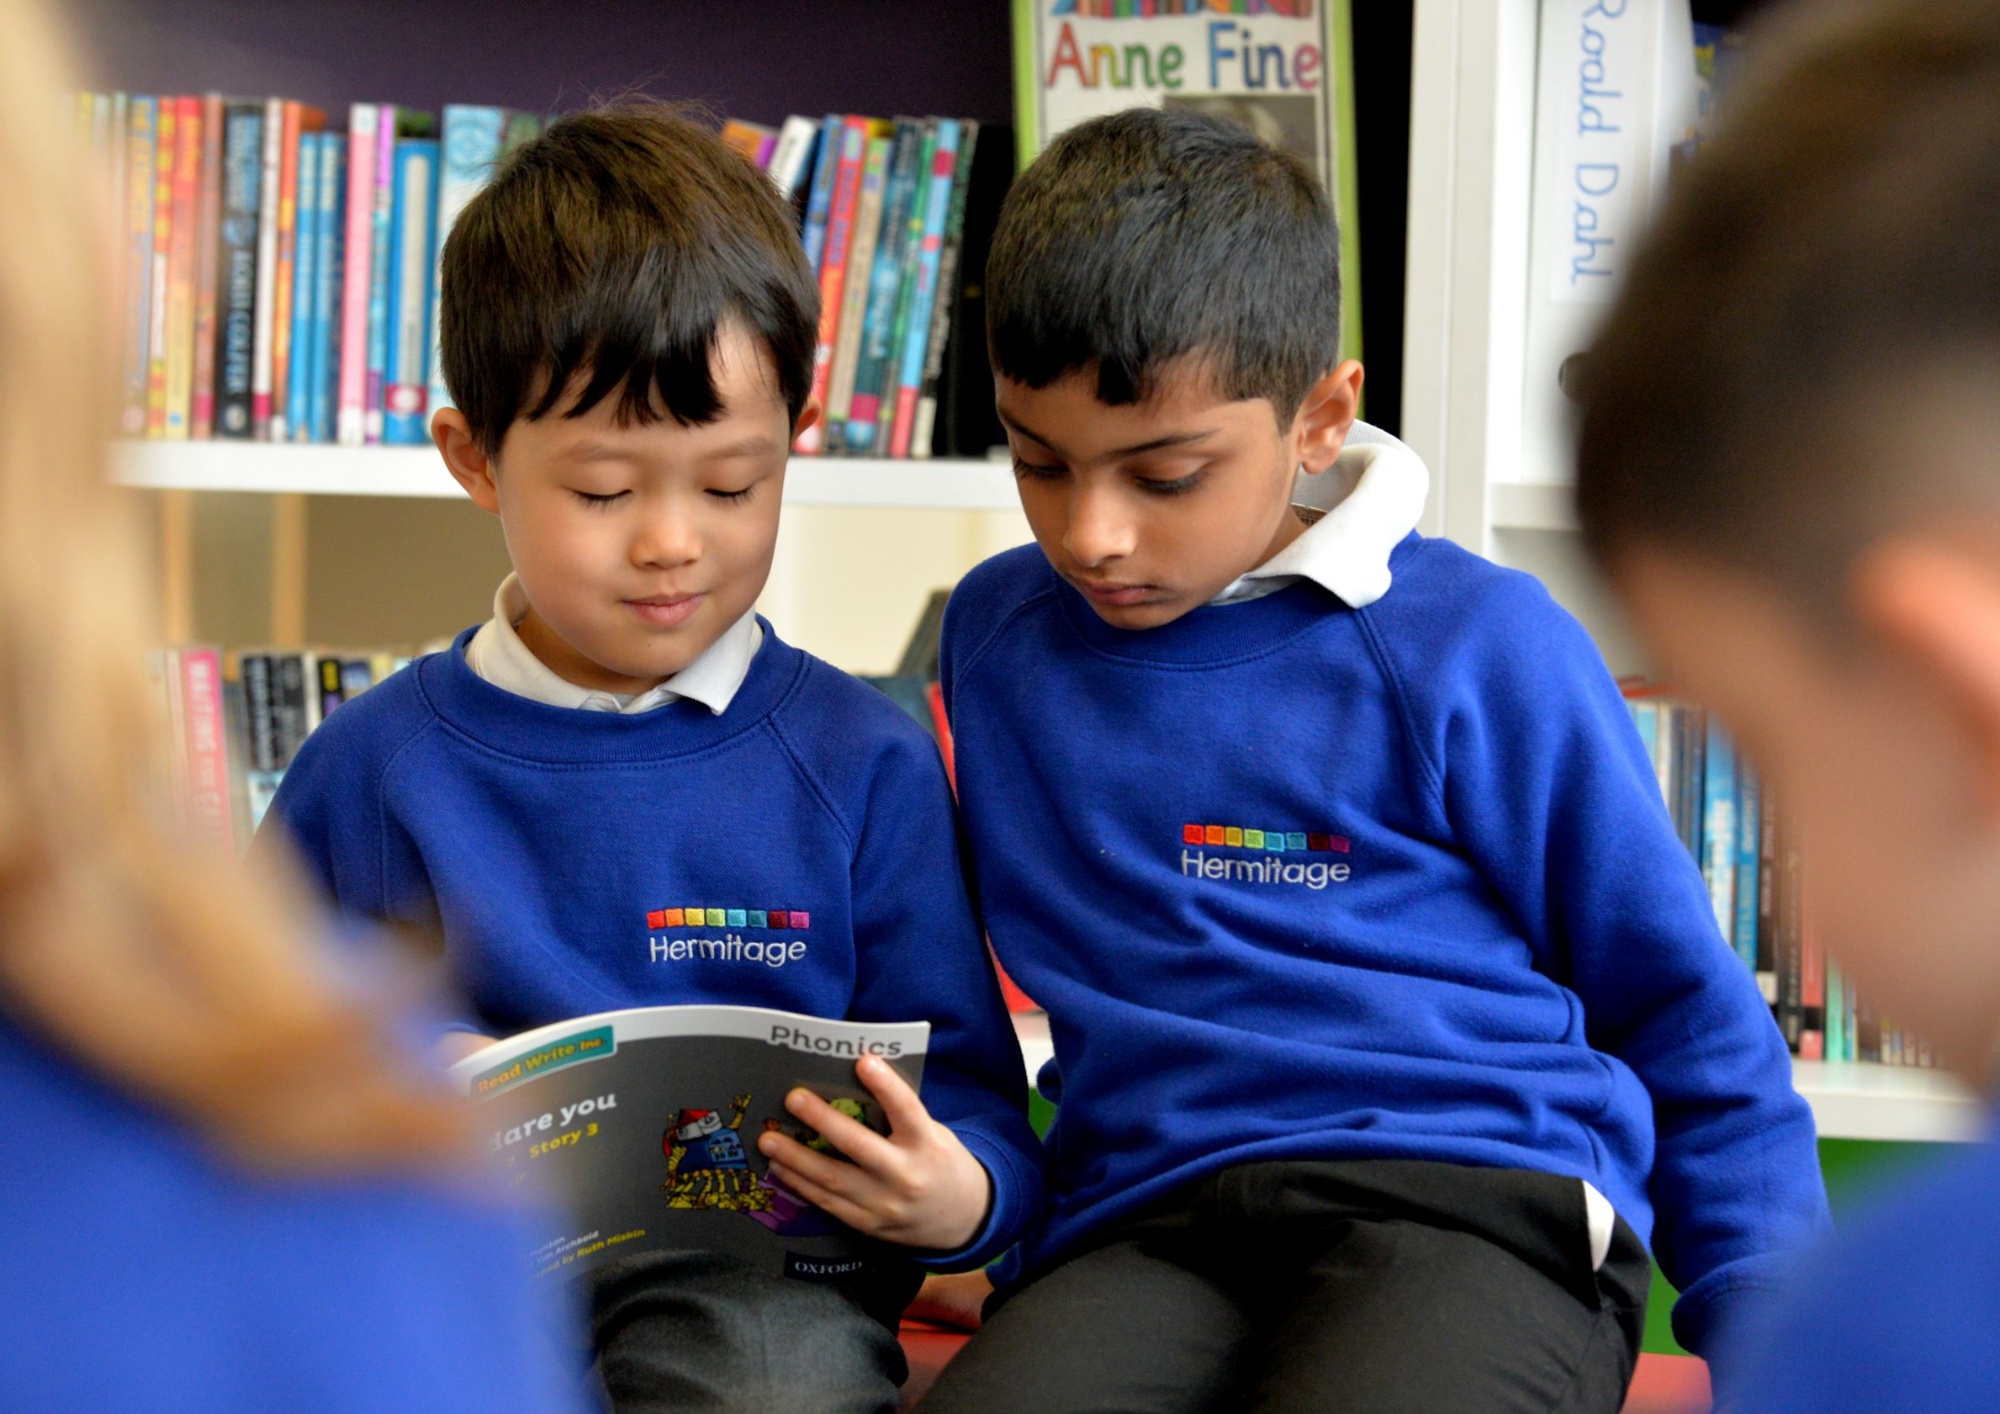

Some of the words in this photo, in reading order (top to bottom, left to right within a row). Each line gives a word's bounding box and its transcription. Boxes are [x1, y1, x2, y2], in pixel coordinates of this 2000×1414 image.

[1046, 20, 1184, 89] Anne
[1208, 22, 1321, 89] Fine
[1577, 0, 1627, 136] Roald
[1571, 163, 1619, 285] Dahl
[1181, 849, 1351, 890] Hermitage
[649, 933, 807, 968] Hermitage
[770, 1025, 903, 1056] Phonics
[476, 1062, 522, 1093] Read
[524, 1043, 576, 1071] Write
[559, 1093, 618, 1127] you
[529, 1129, 583, 1158] Story
[586, 1122, 599, 1137] 3
[554, 1230, 600, 1255] Archbold
[577, 1241, 605, 1257] Ruth
[607, 1229, 646, 1246] Miskin
[794, 1261, 863, 1274] OXFORD
